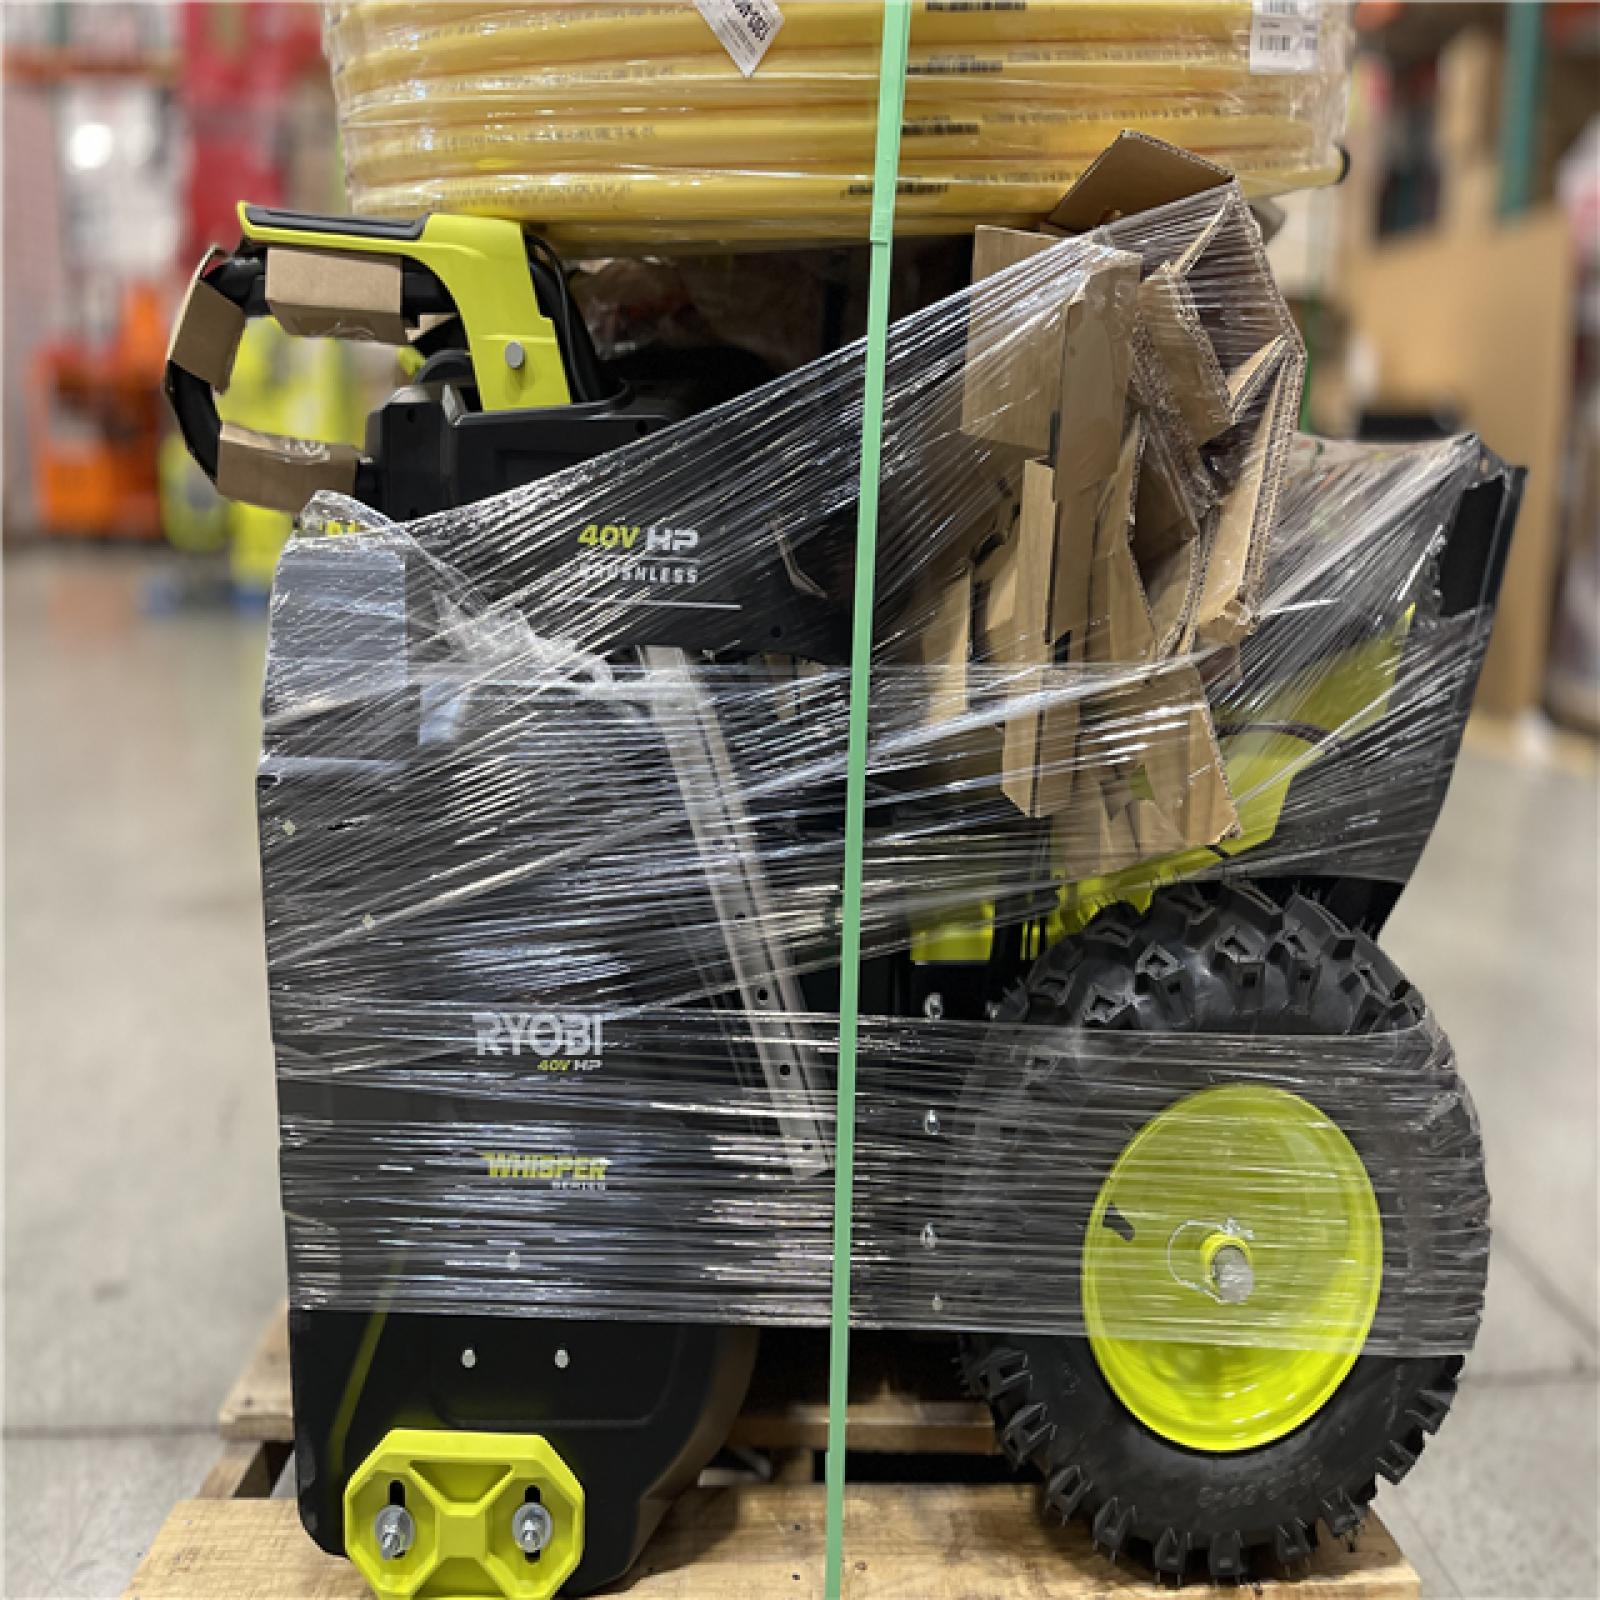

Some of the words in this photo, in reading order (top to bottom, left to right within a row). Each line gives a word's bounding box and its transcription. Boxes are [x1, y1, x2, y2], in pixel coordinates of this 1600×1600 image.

[577, 525, 640, 548] 40V
[646, 525, 698, 551] HP
[473, 1014, 603, 1056] RYOBI
[537, 1059, 570, 1071] 40V
[574, 1059, 603, 1071] HP
[484, 1152, 607, 1181] WHISPER
